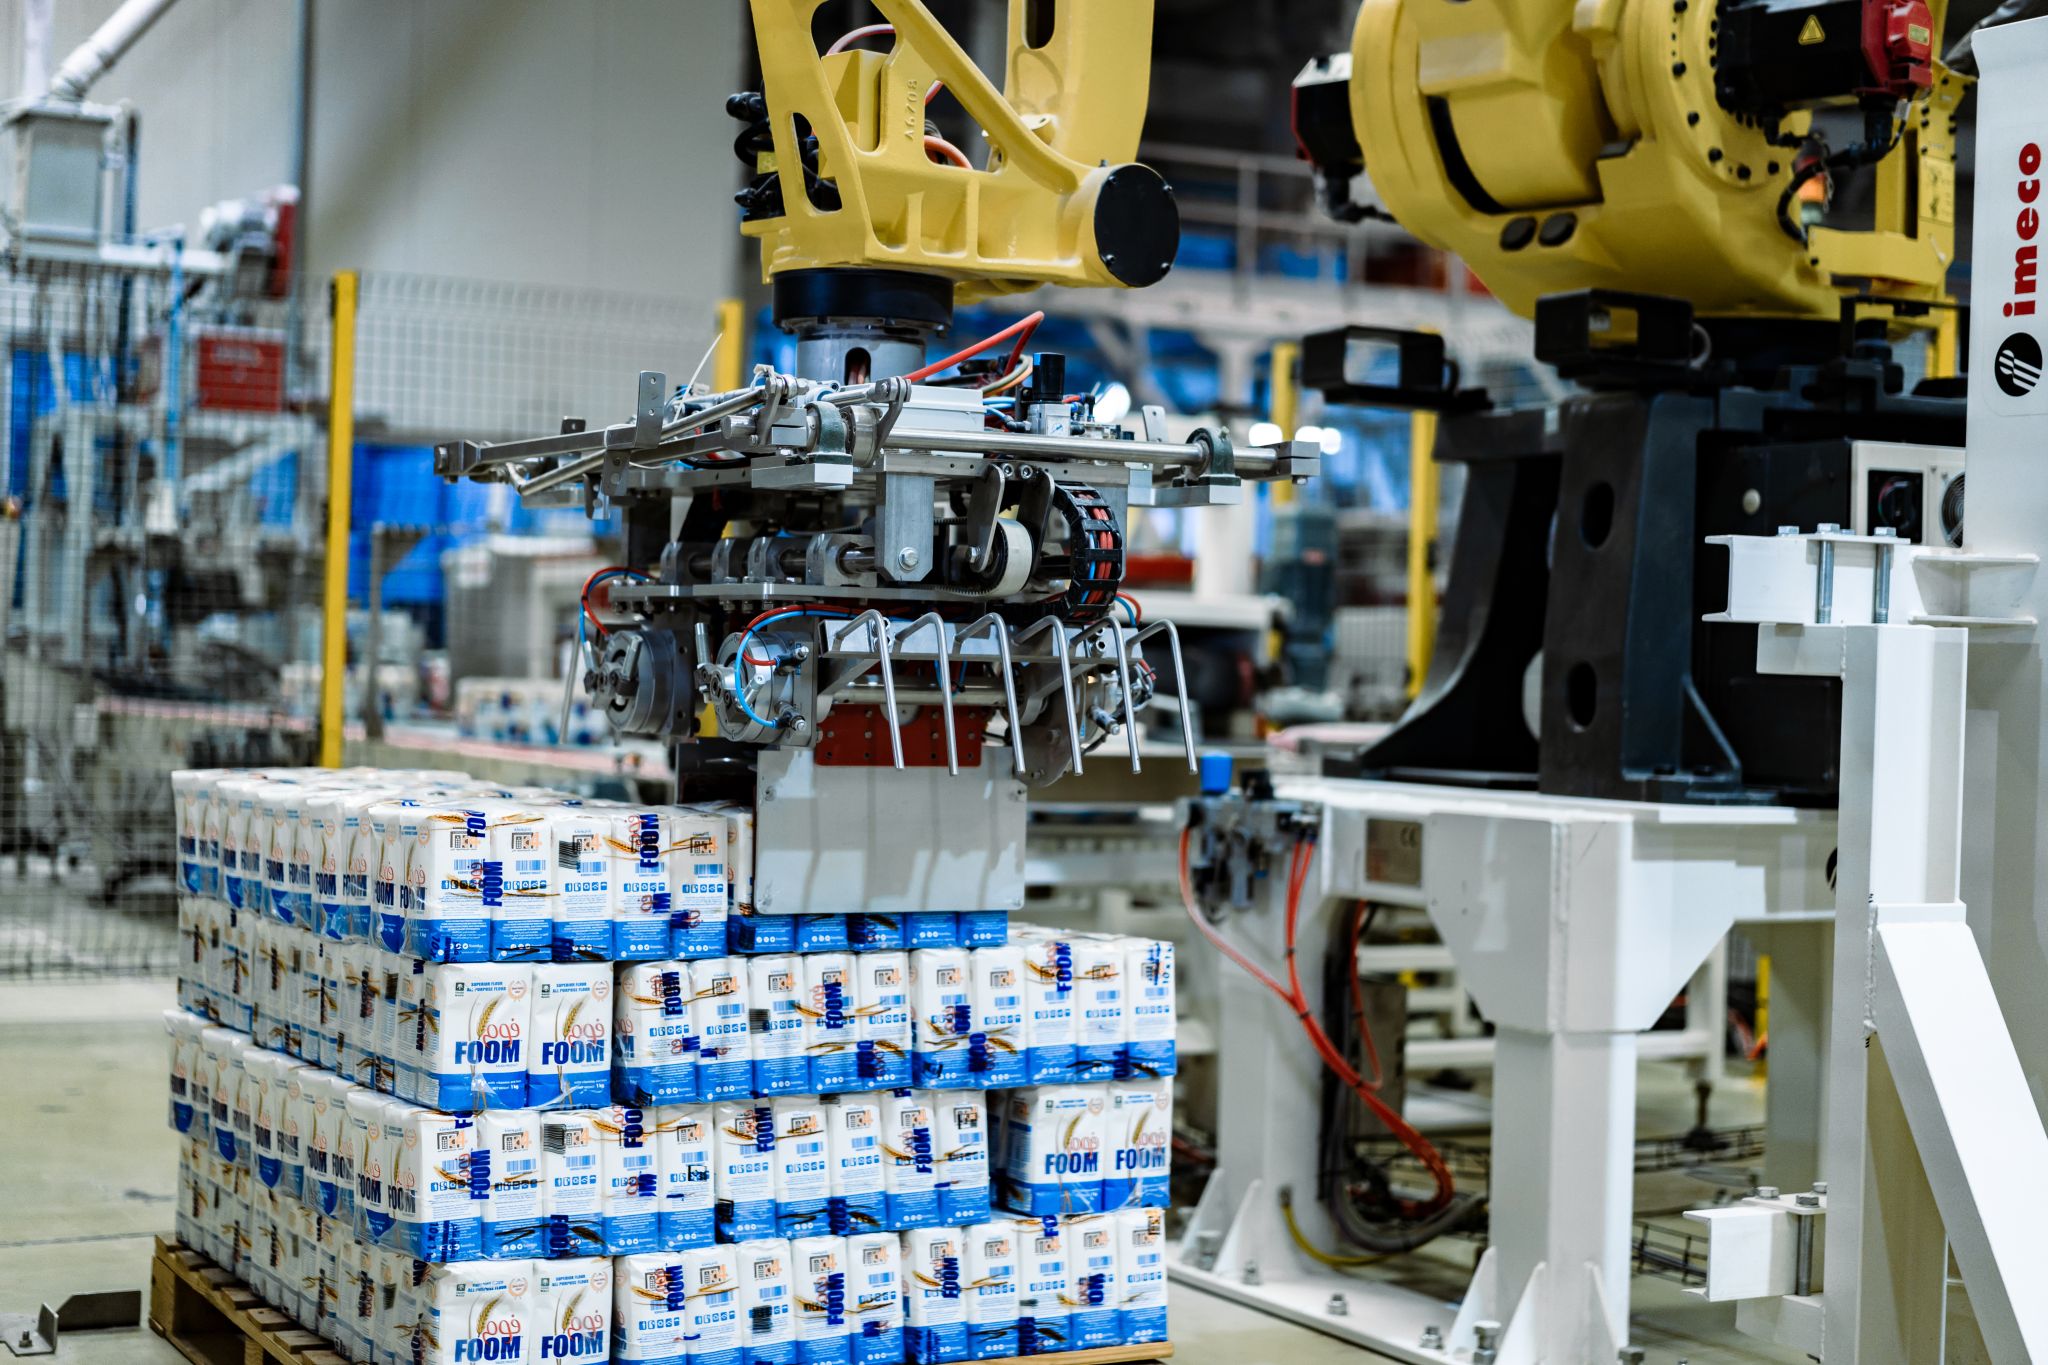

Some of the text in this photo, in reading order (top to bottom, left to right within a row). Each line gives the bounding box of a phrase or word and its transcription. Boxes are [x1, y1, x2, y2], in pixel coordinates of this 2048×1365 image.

[2003, 142, 2041, 317] imeco
[640, 814, 660, 868] FOOM
[483, 862, 503, 907] FOOM
[1055, 942, 1072, 992] FOOM
[825, 982, 843, 1029] FOOM
[454, 1039, 520, 1065] FOOM
[541, 1039, 605, 1065] FOOM
[624, 1106, 643, 1148] FOO
[754, 1107, 775, 1152] FOOM
[913, 1127, 932, 1174] FOOM
[1044, 1151, 1098, 1174] FOOM
[1115, 1146, 1166, 1170] FOOM
[470, 1149, 491, 1200] FOOM
[666, 1265, 685, 1311] FOOM
[827, 1272, 844, 1325] FOOM
[942, 1257, 959, 1299] FOOM
[454, 1335, 521, 1363] FOOM
[541, 1330, 604, 1359] FOOM
